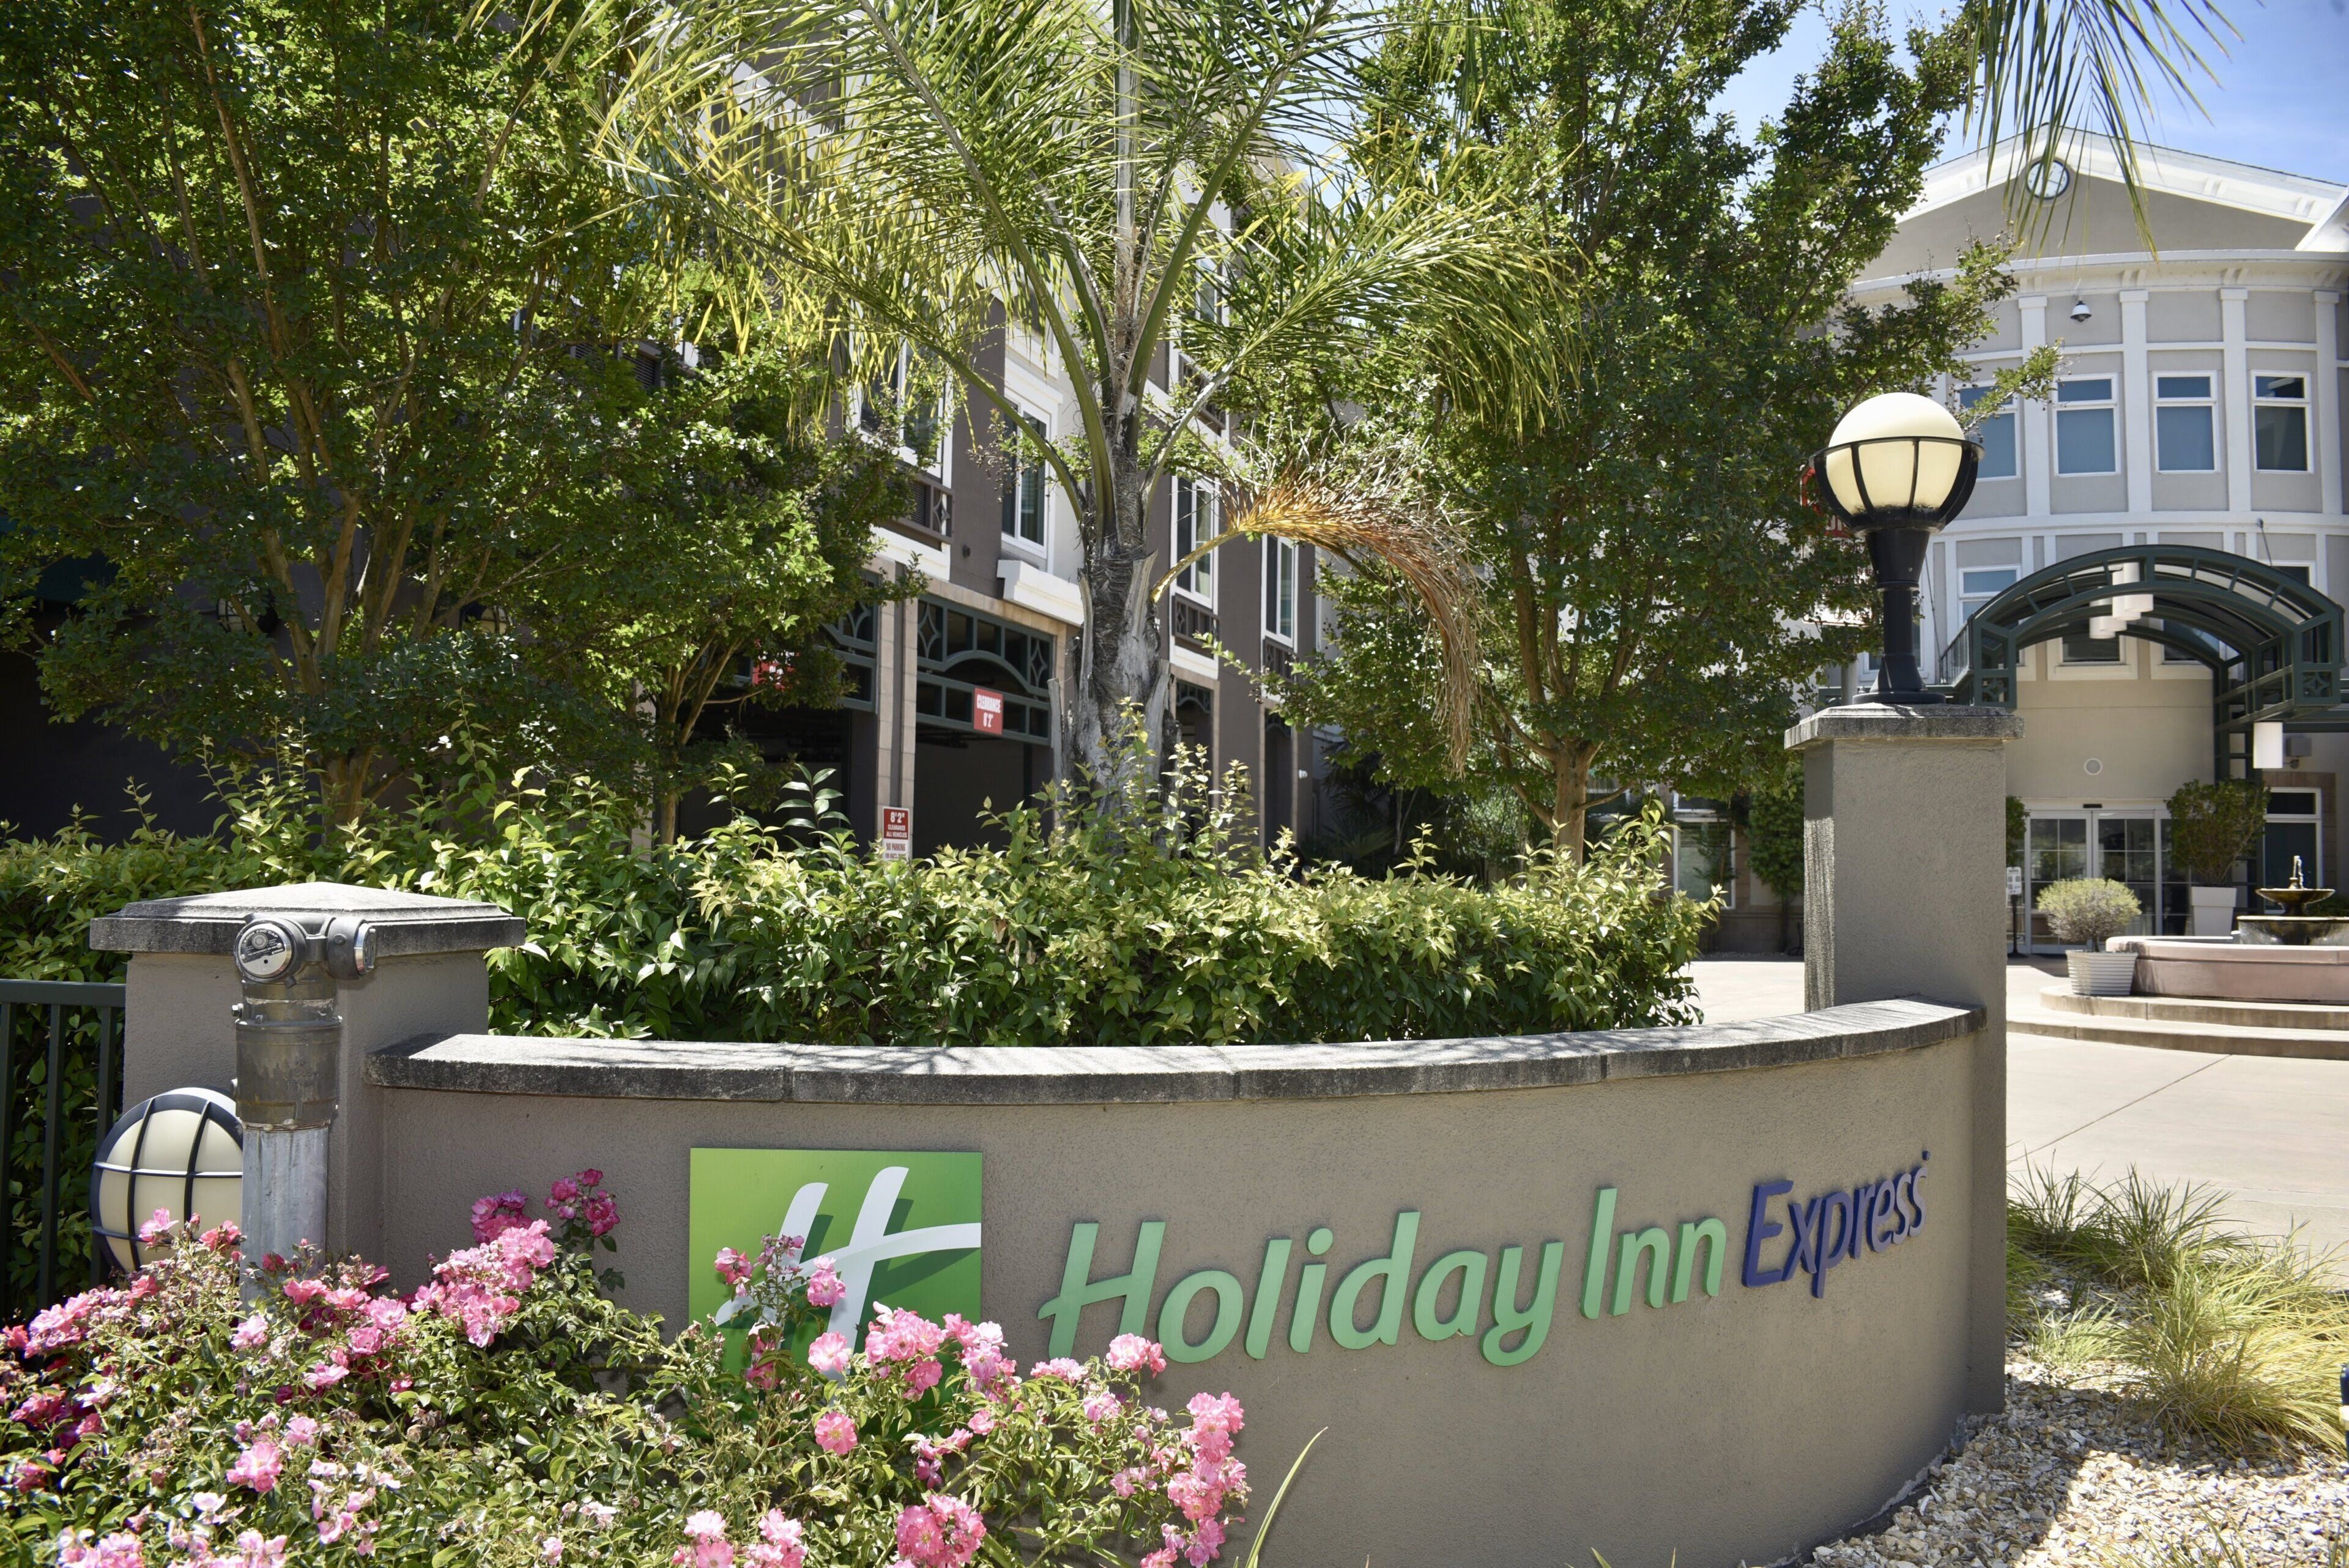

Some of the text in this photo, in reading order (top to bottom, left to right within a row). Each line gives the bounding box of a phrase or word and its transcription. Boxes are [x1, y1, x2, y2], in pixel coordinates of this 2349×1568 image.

[976, 694, 1001, 714] CLEARANCE
[890, 811, 905, 823] 8'2"
[243, 931, 256, 943] KNOX
[1037, 1167, 1928, 1367] Holiday Inn Express
